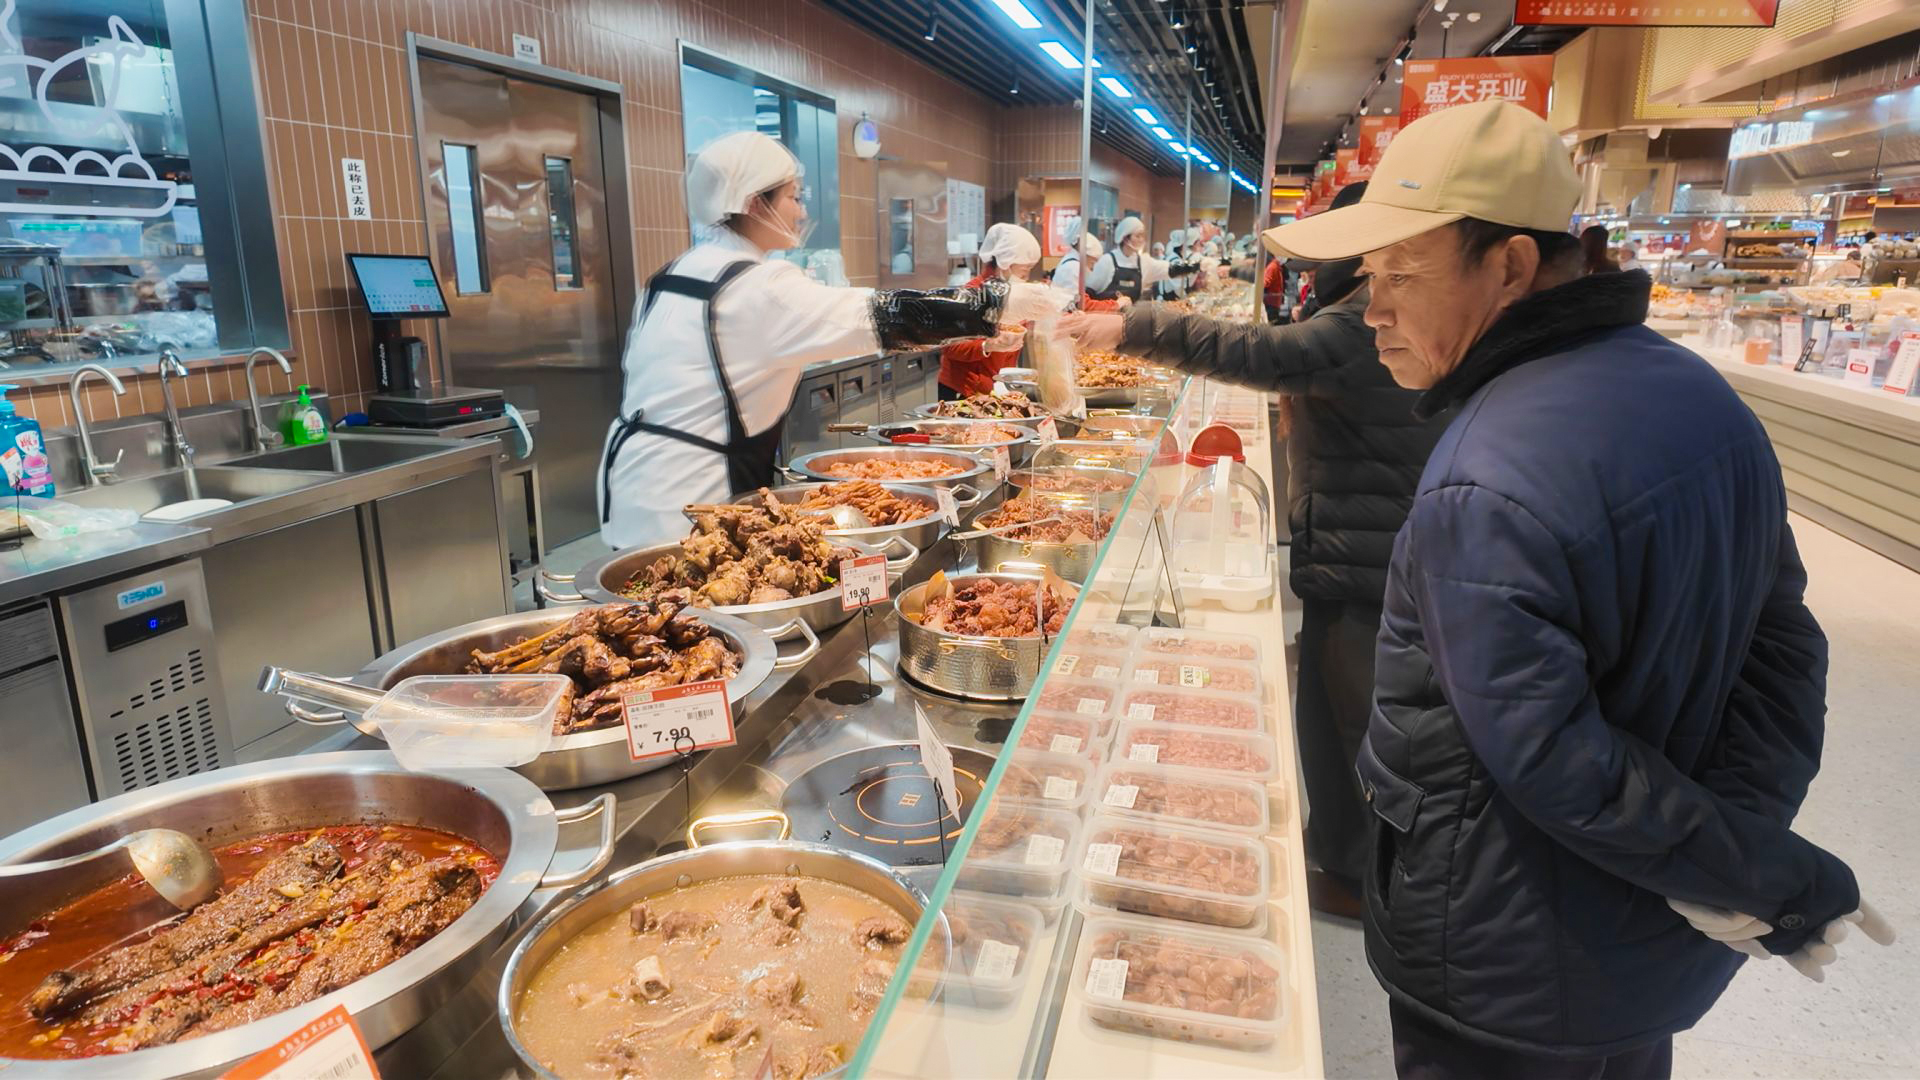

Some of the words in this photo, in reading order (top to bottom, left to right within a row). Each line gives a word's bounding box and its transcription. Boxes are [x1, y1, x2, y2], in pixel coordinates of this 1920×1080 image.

[1424, 78, 1528, 104] 盛大开业
[347, 162, 367, 217] 此称已去皮
[652, 726, 691, 743] 7.90
